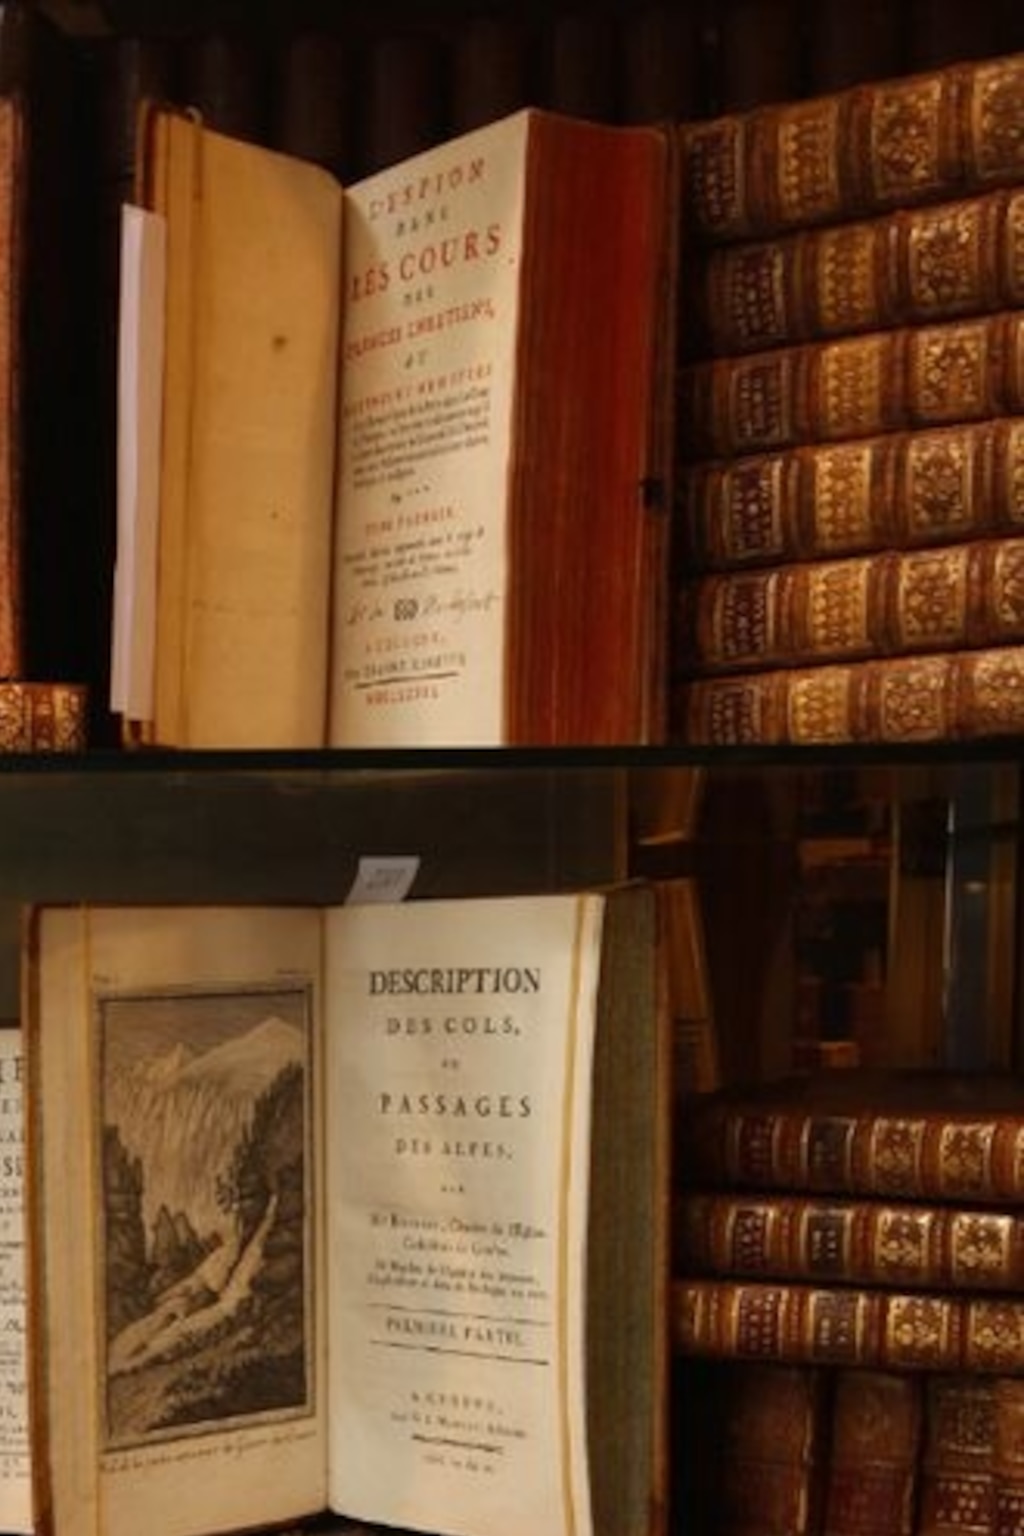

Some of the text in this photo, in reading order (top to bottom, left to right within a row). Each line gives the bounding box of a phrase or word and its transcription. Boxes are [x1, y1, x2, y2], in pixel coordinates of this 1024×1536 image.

[399, 223, 503, 282] COURS
[368, 968, 541, 996] DESCRIPTION
[386, 1017, 433, 1035] DES
[380, 1093, 532, 1118] PASSAGES
